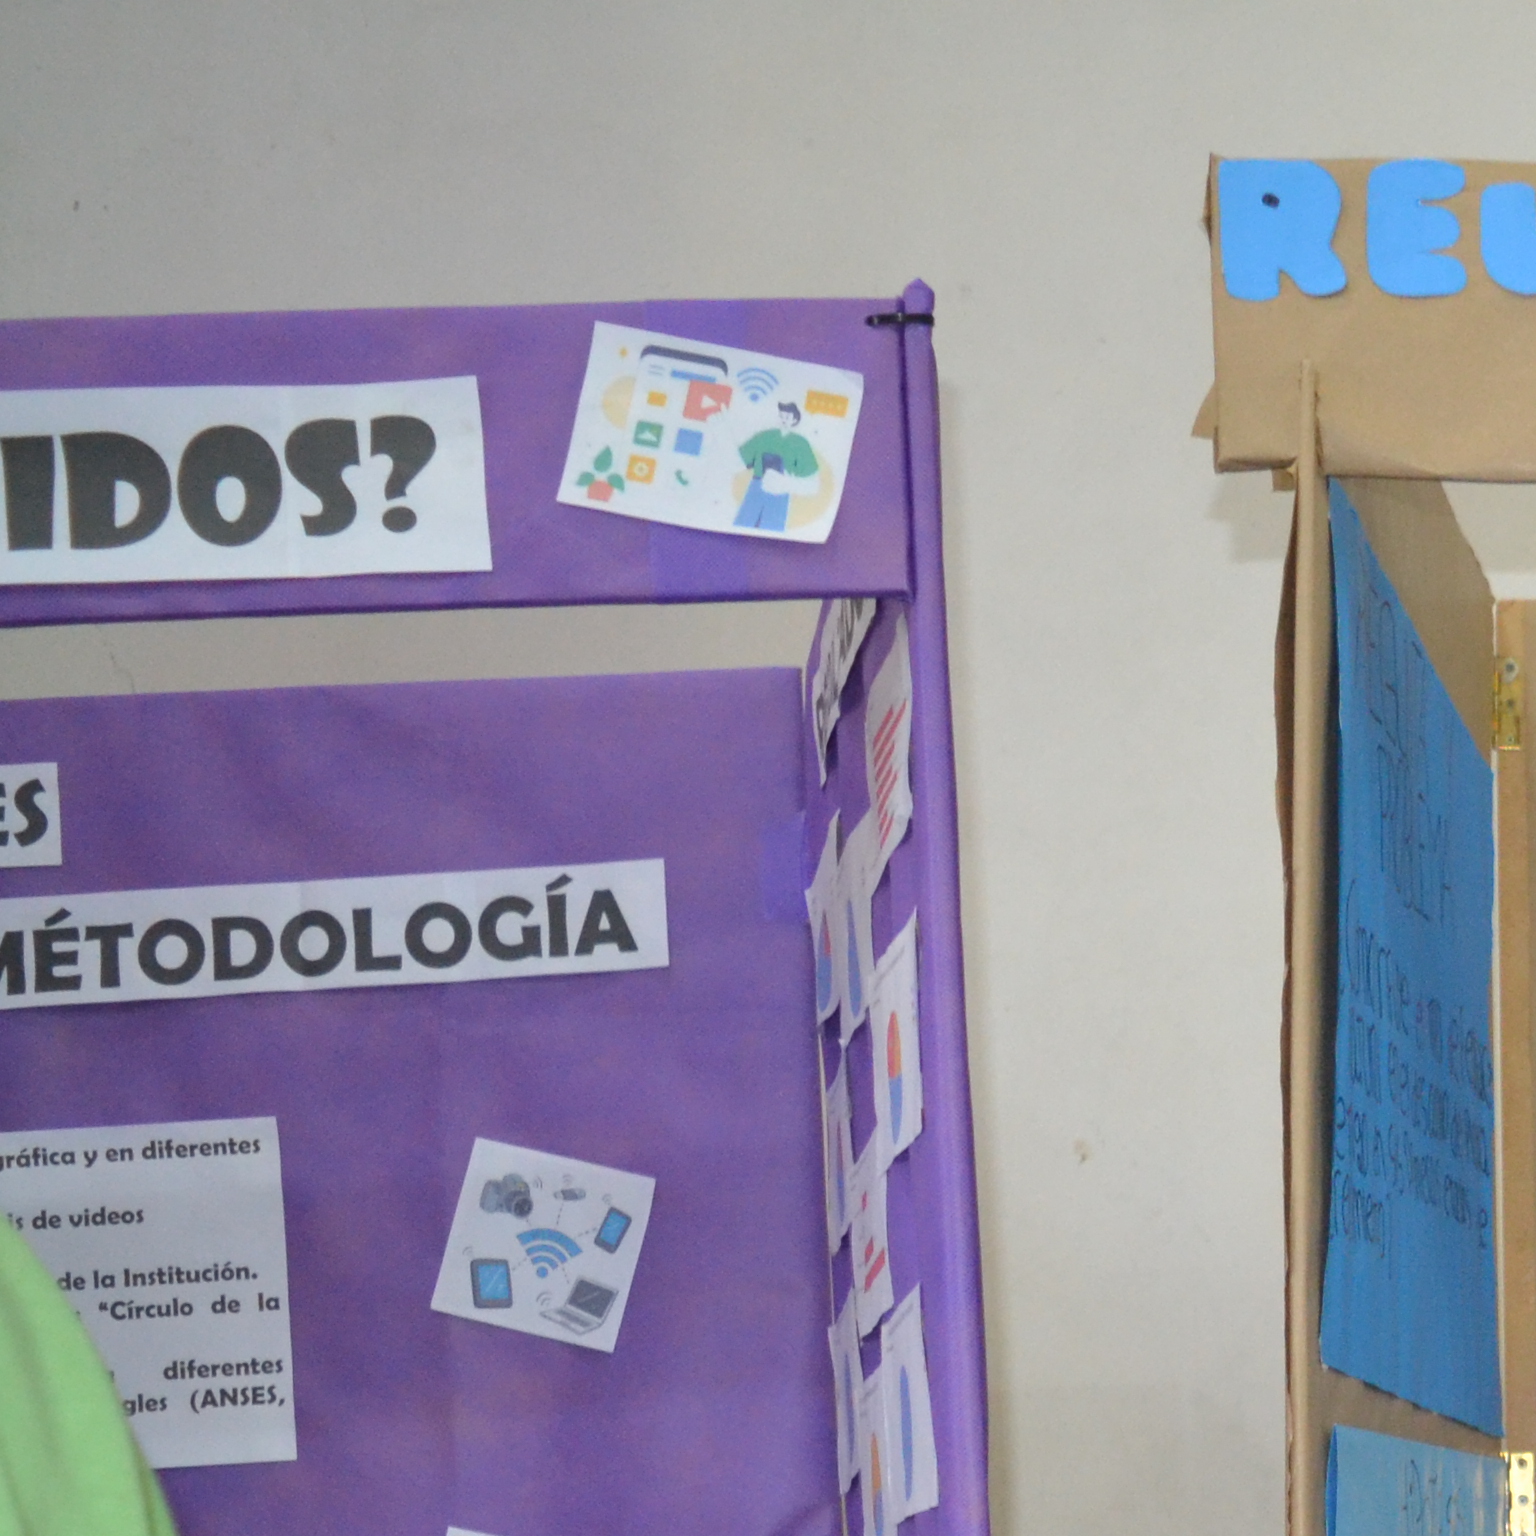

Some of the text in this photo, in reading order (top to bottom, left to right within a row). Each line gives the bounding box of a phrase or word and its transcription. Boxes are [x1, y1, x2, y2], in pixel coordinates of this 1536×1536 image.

[0, 778, 48, 848] S
[83, 1149, 98, 1168] y
[106, 1147, 134, 1163] en
[141, 1138, 262, 1161] diferentes
[32, 1209, 63, 1229] de
[69, 1206, 145, 1228] videos
[57, 1262, 259, 1291] de la Institución.
[211, 1294, 242, 1315] de
[258, 1292, 281, 1313] la
[163, 1357, 284, 1381] diferentes
